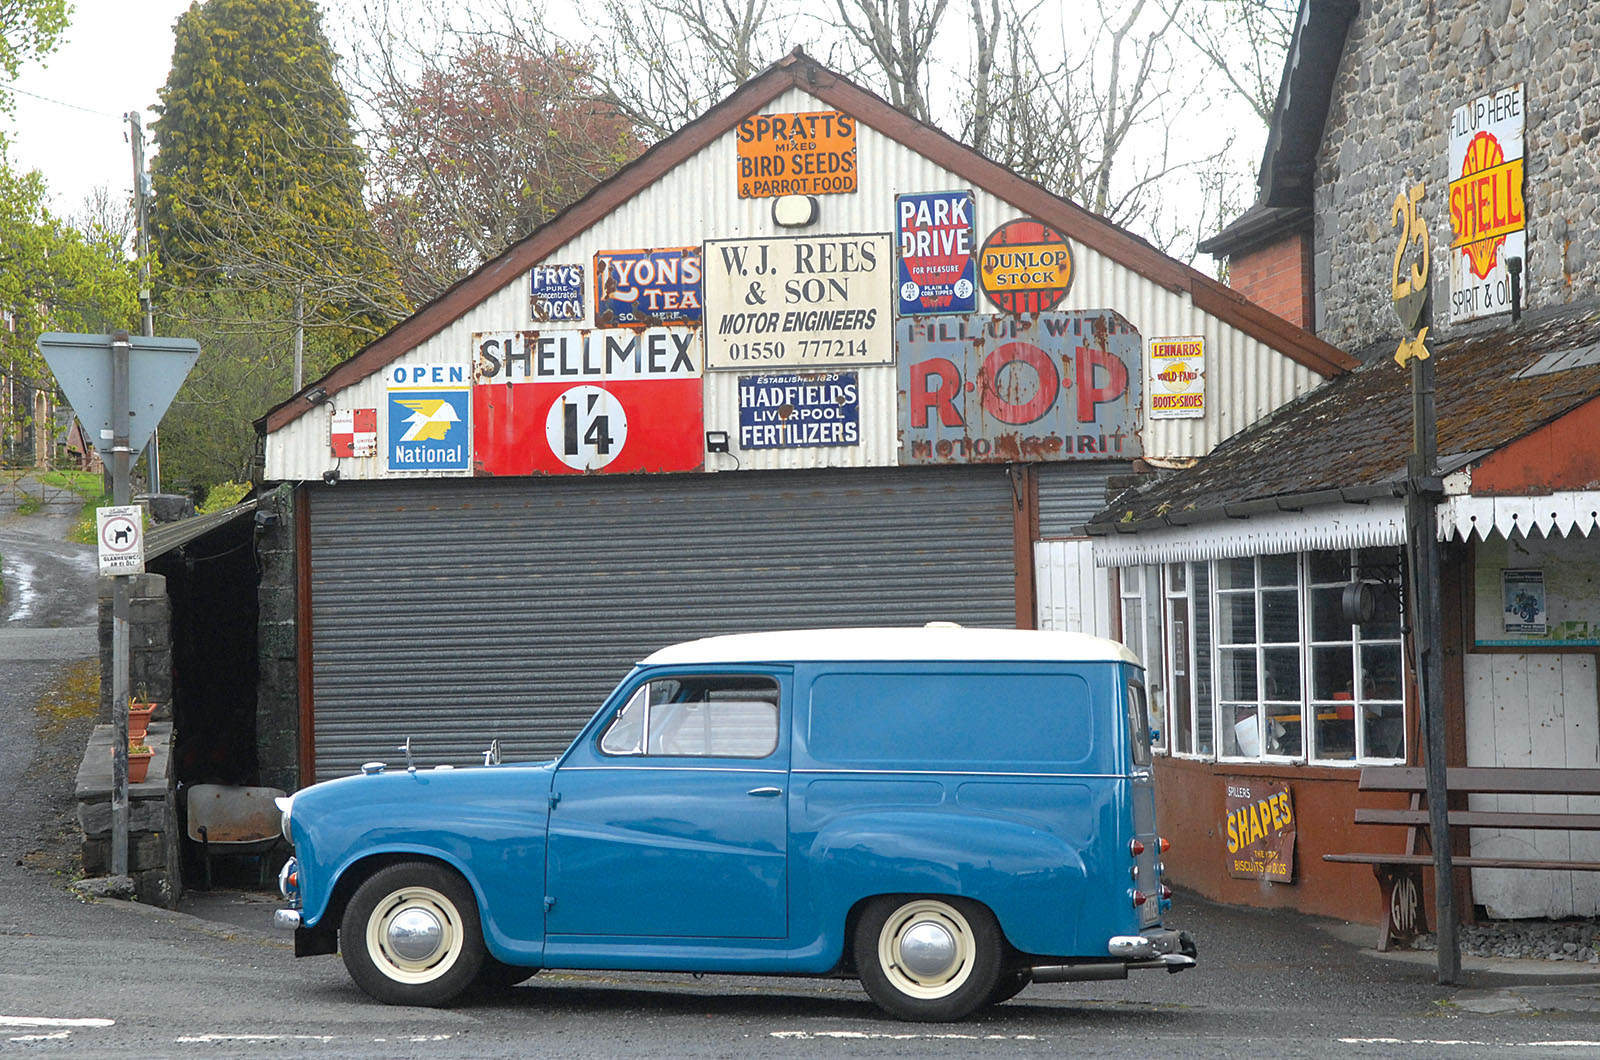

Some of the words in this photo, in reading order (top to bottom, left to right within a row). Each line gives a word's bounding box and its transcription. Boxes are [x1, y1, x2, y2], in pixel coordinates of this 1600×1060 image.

[1451, 108, 1468, 139] FILL
[1470, 102, 1485, 131] UP
[1488, 90, 1520, 125] HERE
[776, 142, 817, 152] MIXED
[742, 155, 785, 178] BIRD
[791, 151, 854, 175] SEEDS
[742, 183, 751, 195] &
[754, 178, 808, 194] PARROT
[813, 176, 853, 191] FOOD
[901, 198, 969, 228] PARK
[1452, 169, 1521, 238] SHELL
[902, 228, 971, 258] DRIVE
[1392, 182, 1429, 300] 25
[794, 241, 877, 275] REES
[985, 251, 1067, 269] DUNLOP
[600, 256, 702, 302] LYONS
[912, 266, 925, 274] FOR
[926, 265, 960, 274] PLEASURE
[997, 271, 1056, 286] STOCK
[643, 288, 701, 310] TEA
[745, 281, 767, 305] &
[785, 278, 849, 304] SON
[1452, 285, 1480, 316] SPIRIT
[1484, 283, 1493, 307] &
[719, 312, 780, 335] MOTOR
[782, 308, 877, 333] ENGINEERS
[481, 333, 695, 378] SHELLMEX
[729, 342, 785, 360] 01550
[798, 339, 867, 357] 777214
[1153, 343, 1201, 357] LENNARDS
[394, 366, 463, 383] OPEN
[757, 376, 815, 385] ESTABLISHED
[817, 374, 839, 382] 1820
[741, 384, 857, 408] HADFIELDS
[1153, 396, 1176, 408] BOOTS
[1179, 395, 1203, 407] SHOES
[754, 408, 846, 422] LIVRPOOL
[742, 422, 857, 446] FERTILIZERS
[396, 444, 461, 463] National
[1228, 786, 1251, 798] SPILLERS
[1234, 860, 1265, 873] BISCUITS
[1272, 862, 1287, 875] DOGS
